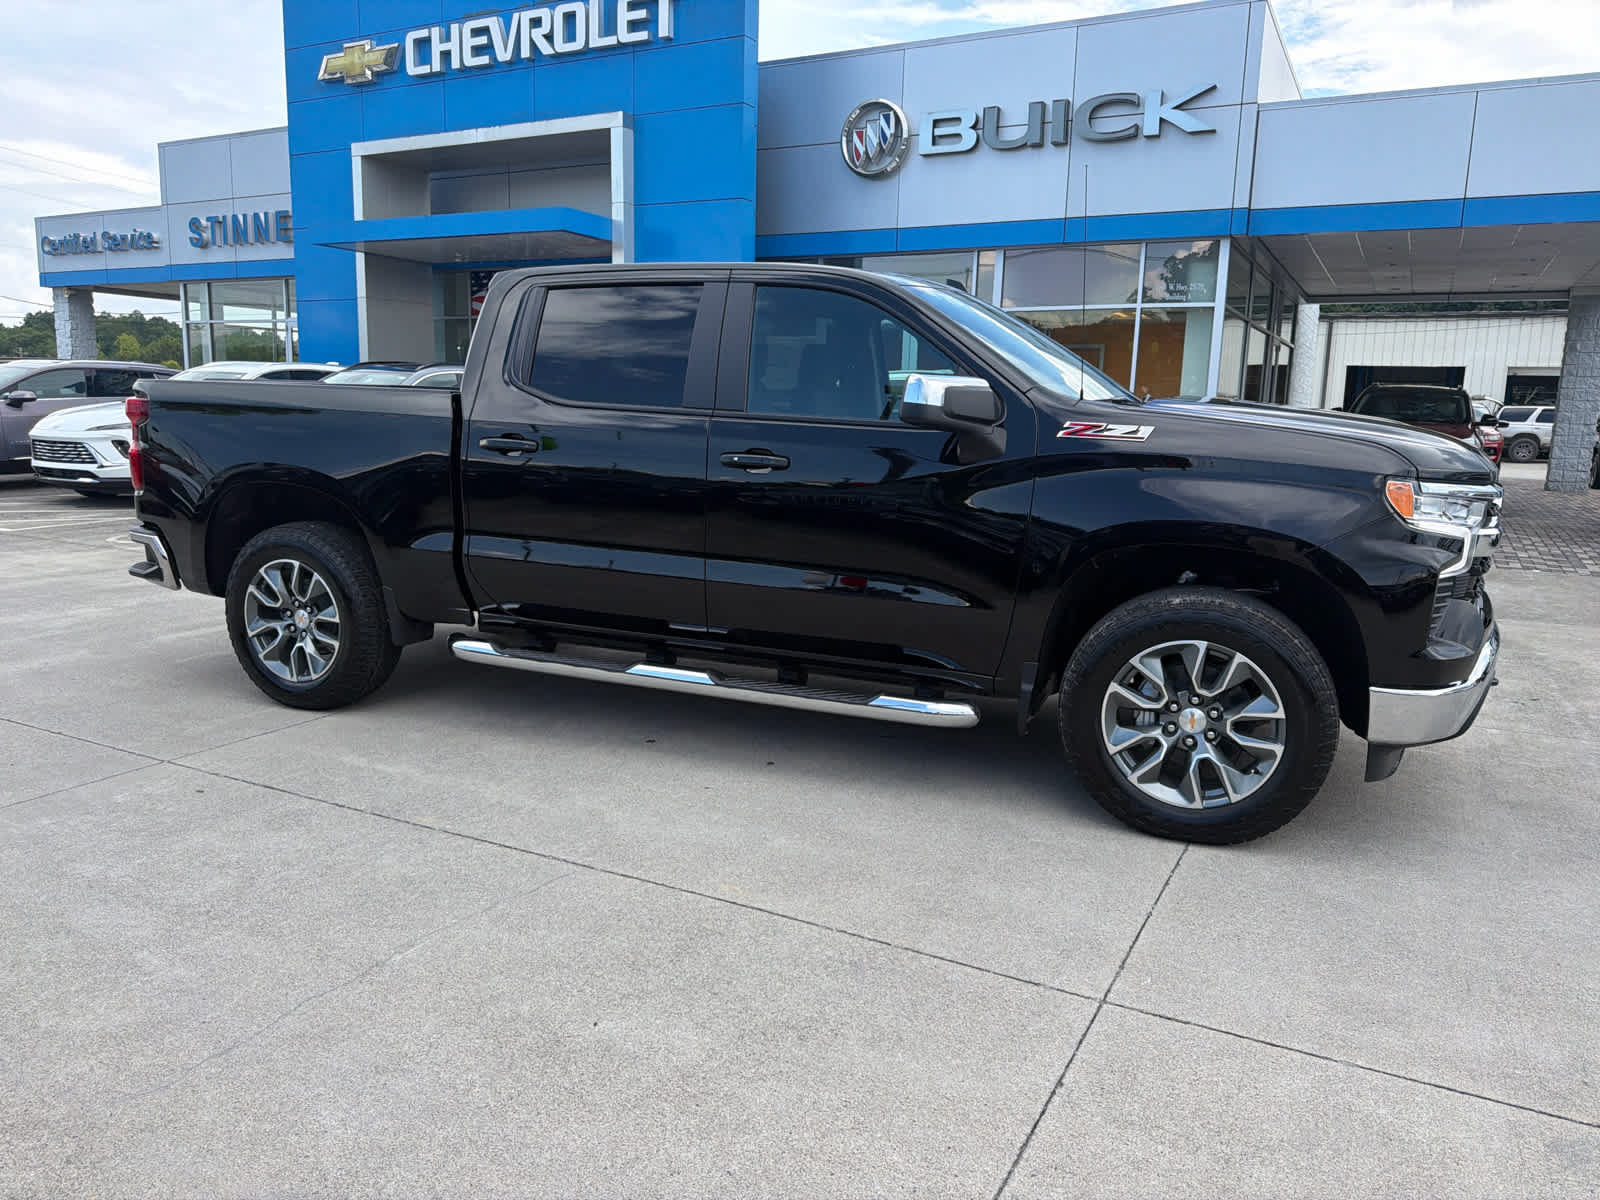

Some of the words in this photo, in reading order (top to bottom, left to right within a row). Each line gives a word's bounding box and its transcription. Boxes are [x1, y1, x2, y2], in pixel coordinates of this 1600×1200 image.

[919, 85, 1217, 156] BUICK
[41, 231, 98, 256] Certified
[102, 227, 157, 251] Service
[1056, 421, 1156, 442] Z71
